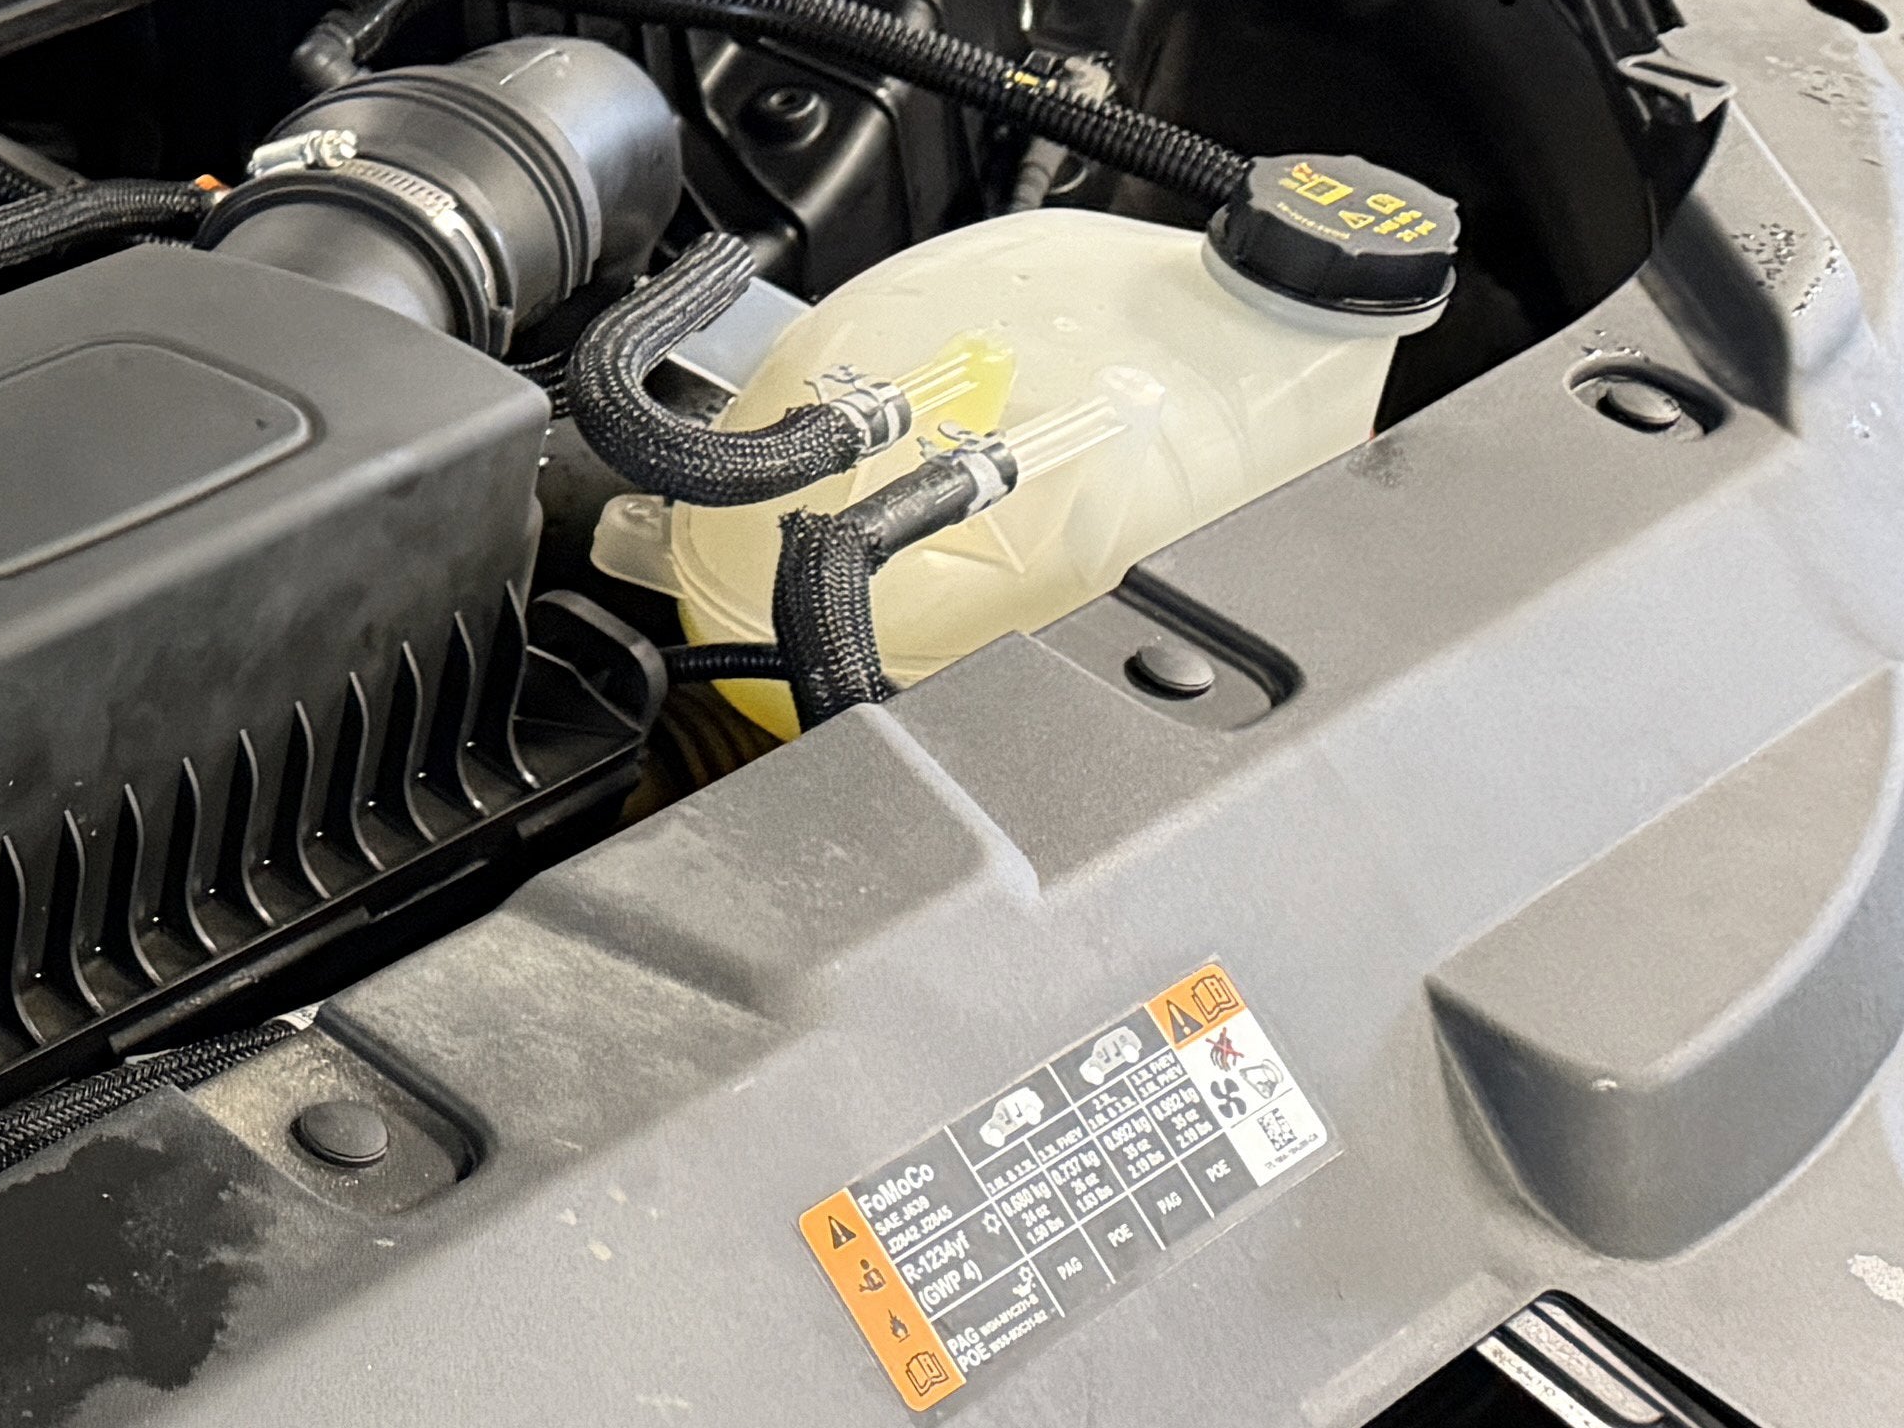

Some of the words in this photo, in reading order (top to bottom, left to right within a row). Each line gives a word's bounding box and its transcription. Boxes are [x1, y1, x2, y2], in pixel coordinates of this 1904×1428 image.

[1152, 1093, 1185, 1121] 0.992
[1179, 1087, 1200, 1104] kg
[1185, 1109, 1200, 1122] oz
[1103, 1123, 1136, 1151] 0.992
[1131, 1116, 1152, 1133] kg
[1195, 1121, 1213, 1136] lbs
[1136, 1138, 1152, 1152] oz
[1051, 1156, 1082, 1186] 0.737
[1078, 1150, 1101, 1168] kg
[1146, 1150, 1165, 1166] lbs
[1085, 1173, 1100, 1187] oz
[1206, 1159, 1231, 1182] POE
[858, 1164, 934, 1218] FoMoCo
[1029, 1181, 1052, 1199] kg
[1095, 1185, 1114, 1201] lbs
[1157, 1192, 1182, 1215] PAG
[875, 1212, 904, 1236] SAE
[902, 1195, 930, 1221] J639
[1021, 1209, 1038, 1227] 24
[1035, 1204, 1051, 1219] oz
[1045, 1217, 1065, 1233] lbs
[1107, 1224, 1133, 1247] POE
[902, 1230, 970, 1284] R-1234yf
[1057, 1257, 1083, 1280] PAG
[918, 1270, 961, 1313] (GWP
[963, 1260, 983, 1281] 4)
[947, 1327, 980, 1356] PAG
[957, 1342, 991, 1372] POE
